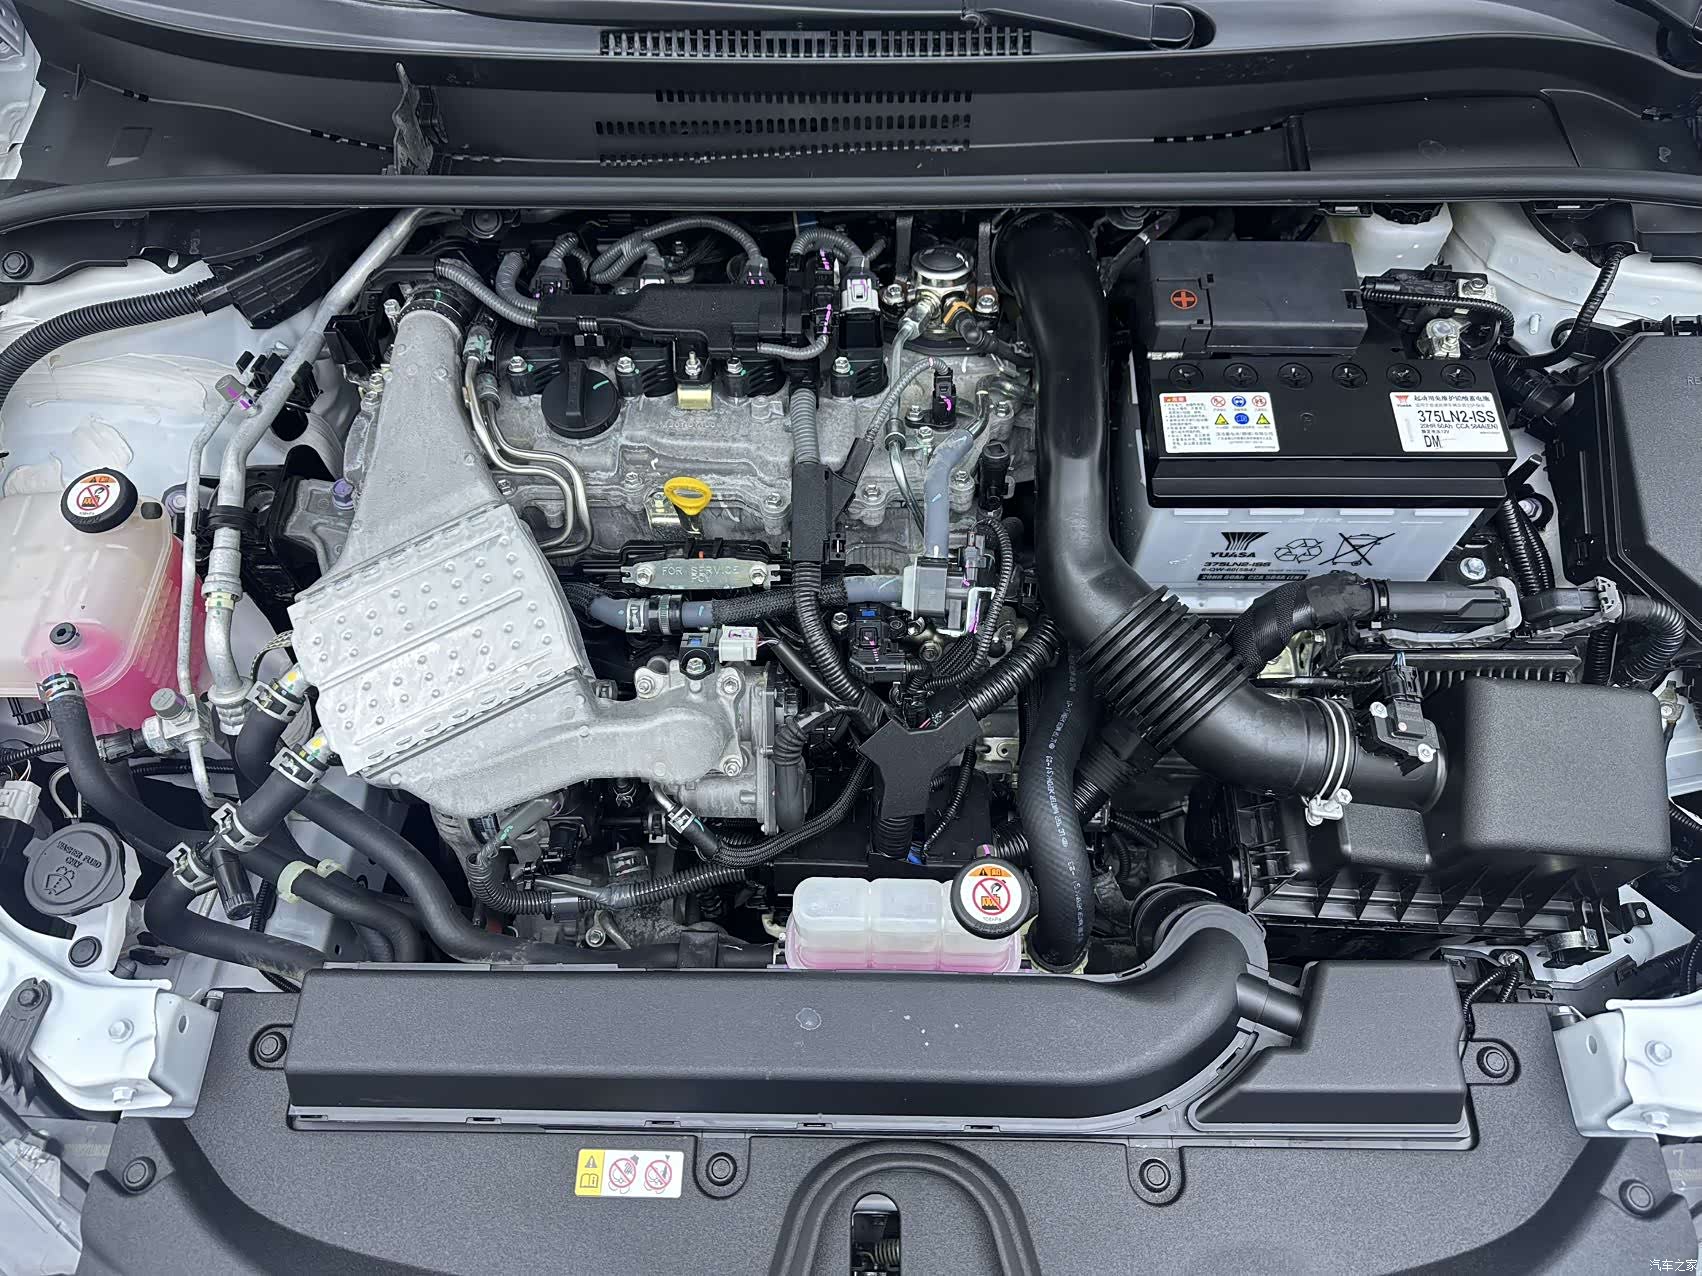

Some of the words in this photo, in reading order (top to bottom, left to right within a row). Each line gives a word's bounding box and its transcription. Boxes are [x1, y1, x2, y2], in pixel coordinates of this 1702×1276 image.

[1417, 410, 1496, 423] 375LN2-ISS
[1424, 434, 1441, 448] DM
[662, 566, 683, 576] FOR
[691, 566, 740, 576] SERVICE
[57, 841, 83, 859] WASHER
[83, 855, 102, 868] FLUID
[65, 857, 83, 868] ONLY
